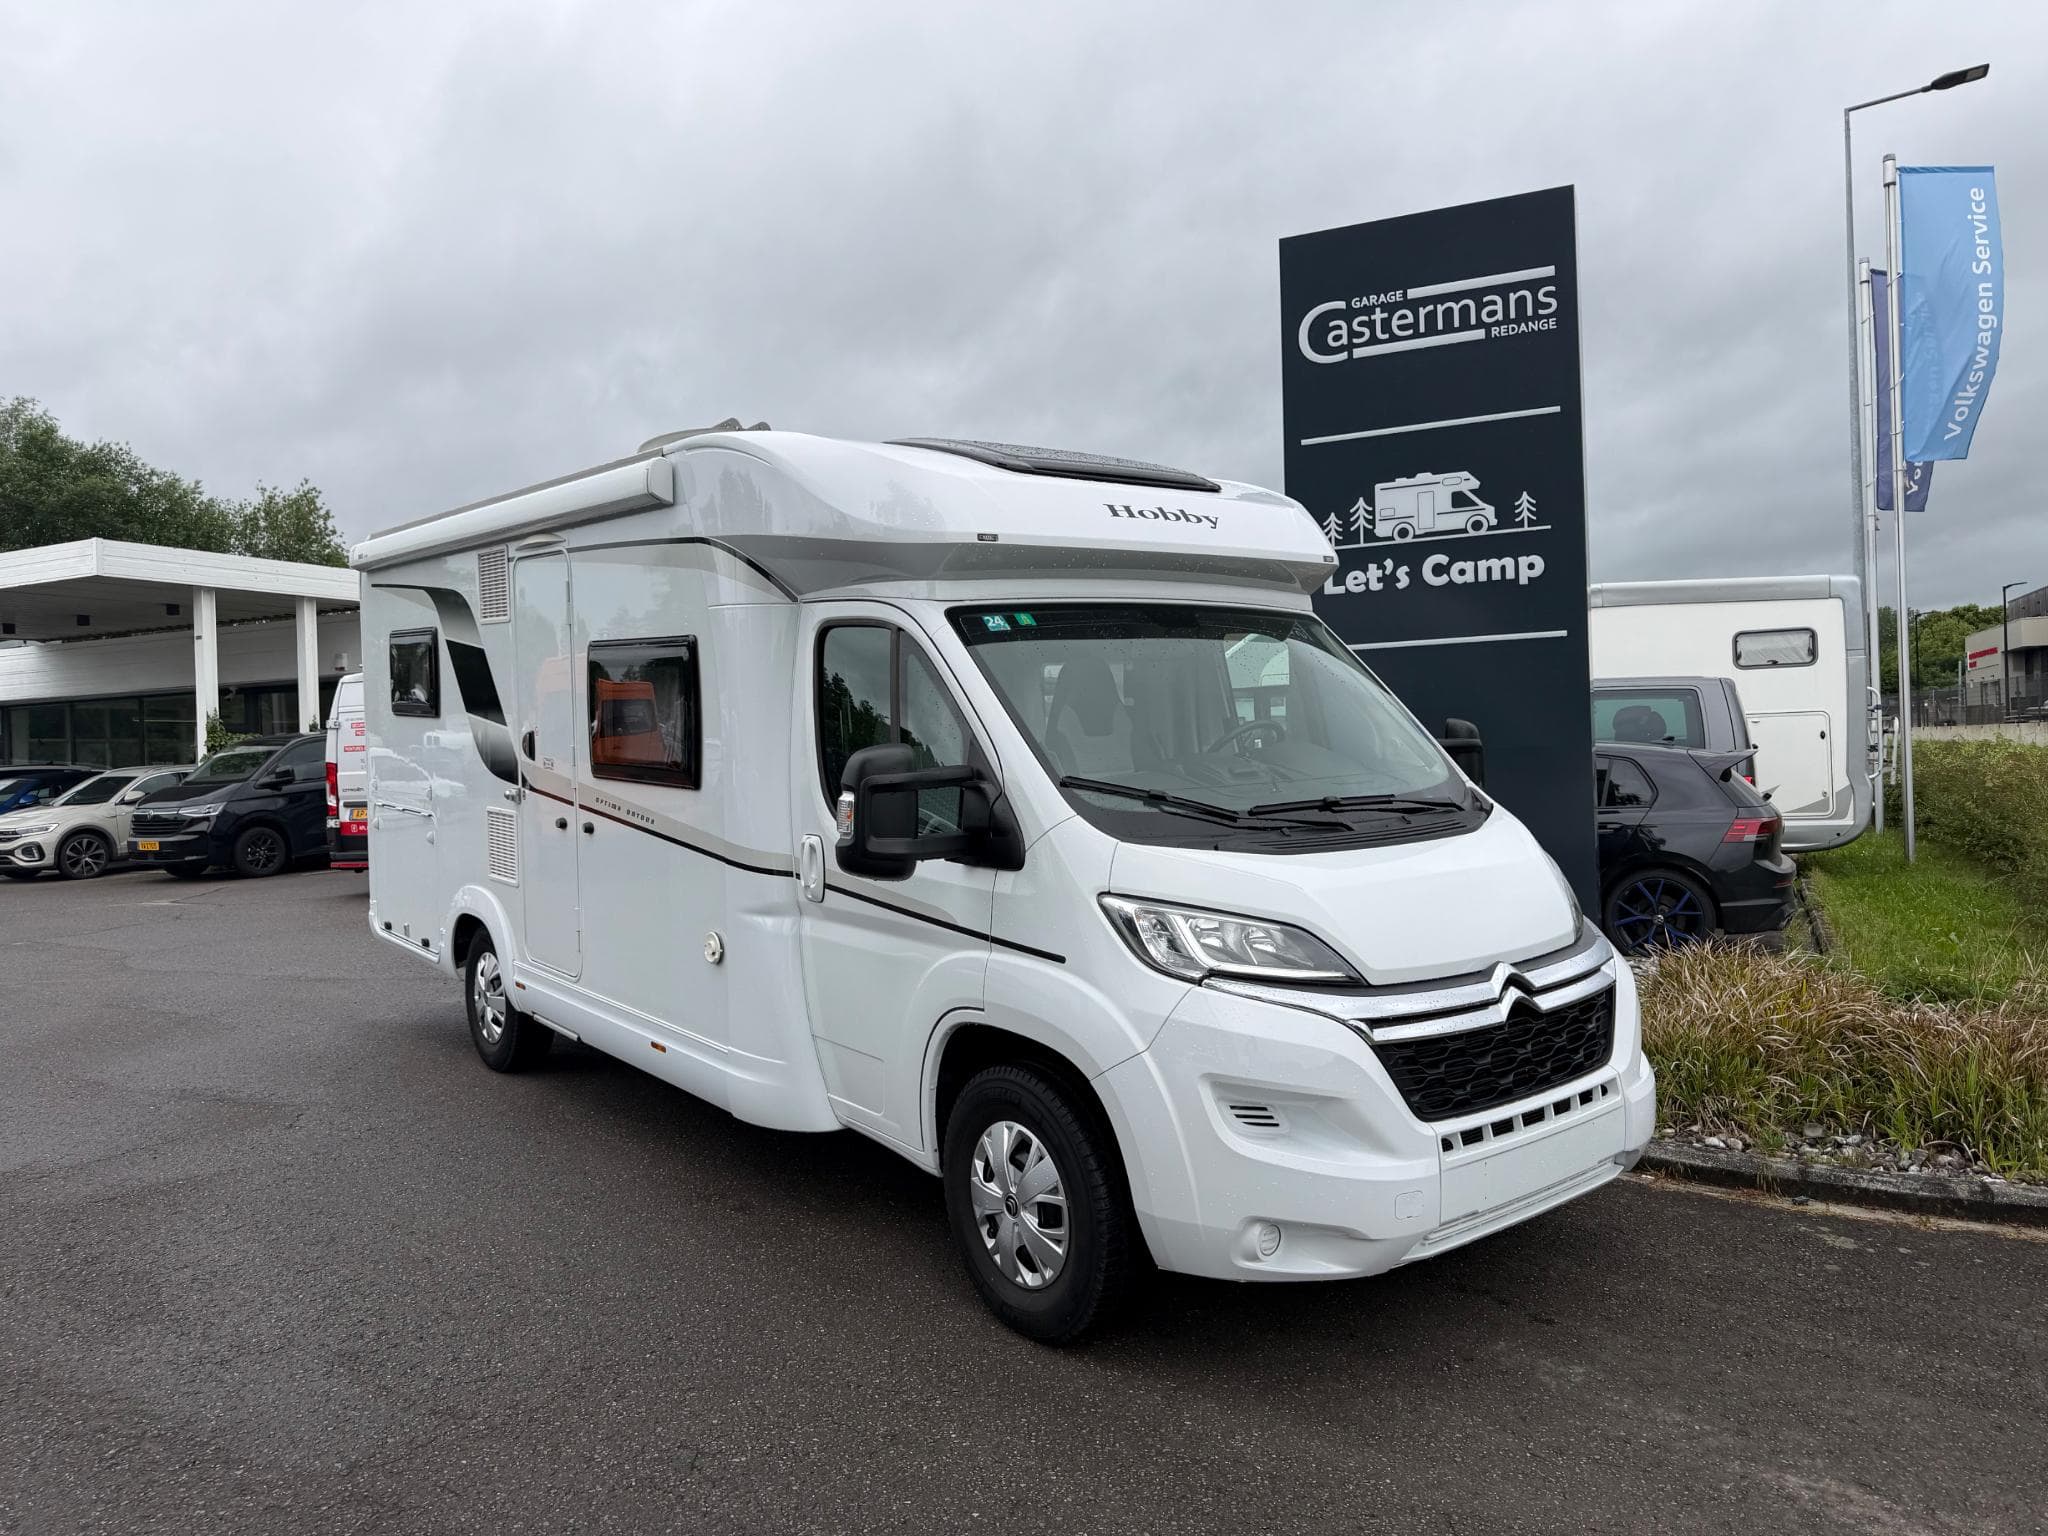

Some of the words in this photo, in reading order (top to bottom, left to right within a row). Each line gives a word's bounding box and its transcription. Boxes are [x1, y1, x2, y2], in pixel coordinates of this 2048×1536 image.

[1967, 187, 1992, 275] Service
[1351, 290, 1404, 309] GARAGE
[1298, 285, 1558, 364] Castermans
[1491, 318, 1557, 338] REDANGE
[1944, 282, 1998, 440] Volkswagen
[1103, 503, 1219, 529] Hobby
[1421, 554, 1545, 586] Camp
[984, 616, 1005, 627] 24
